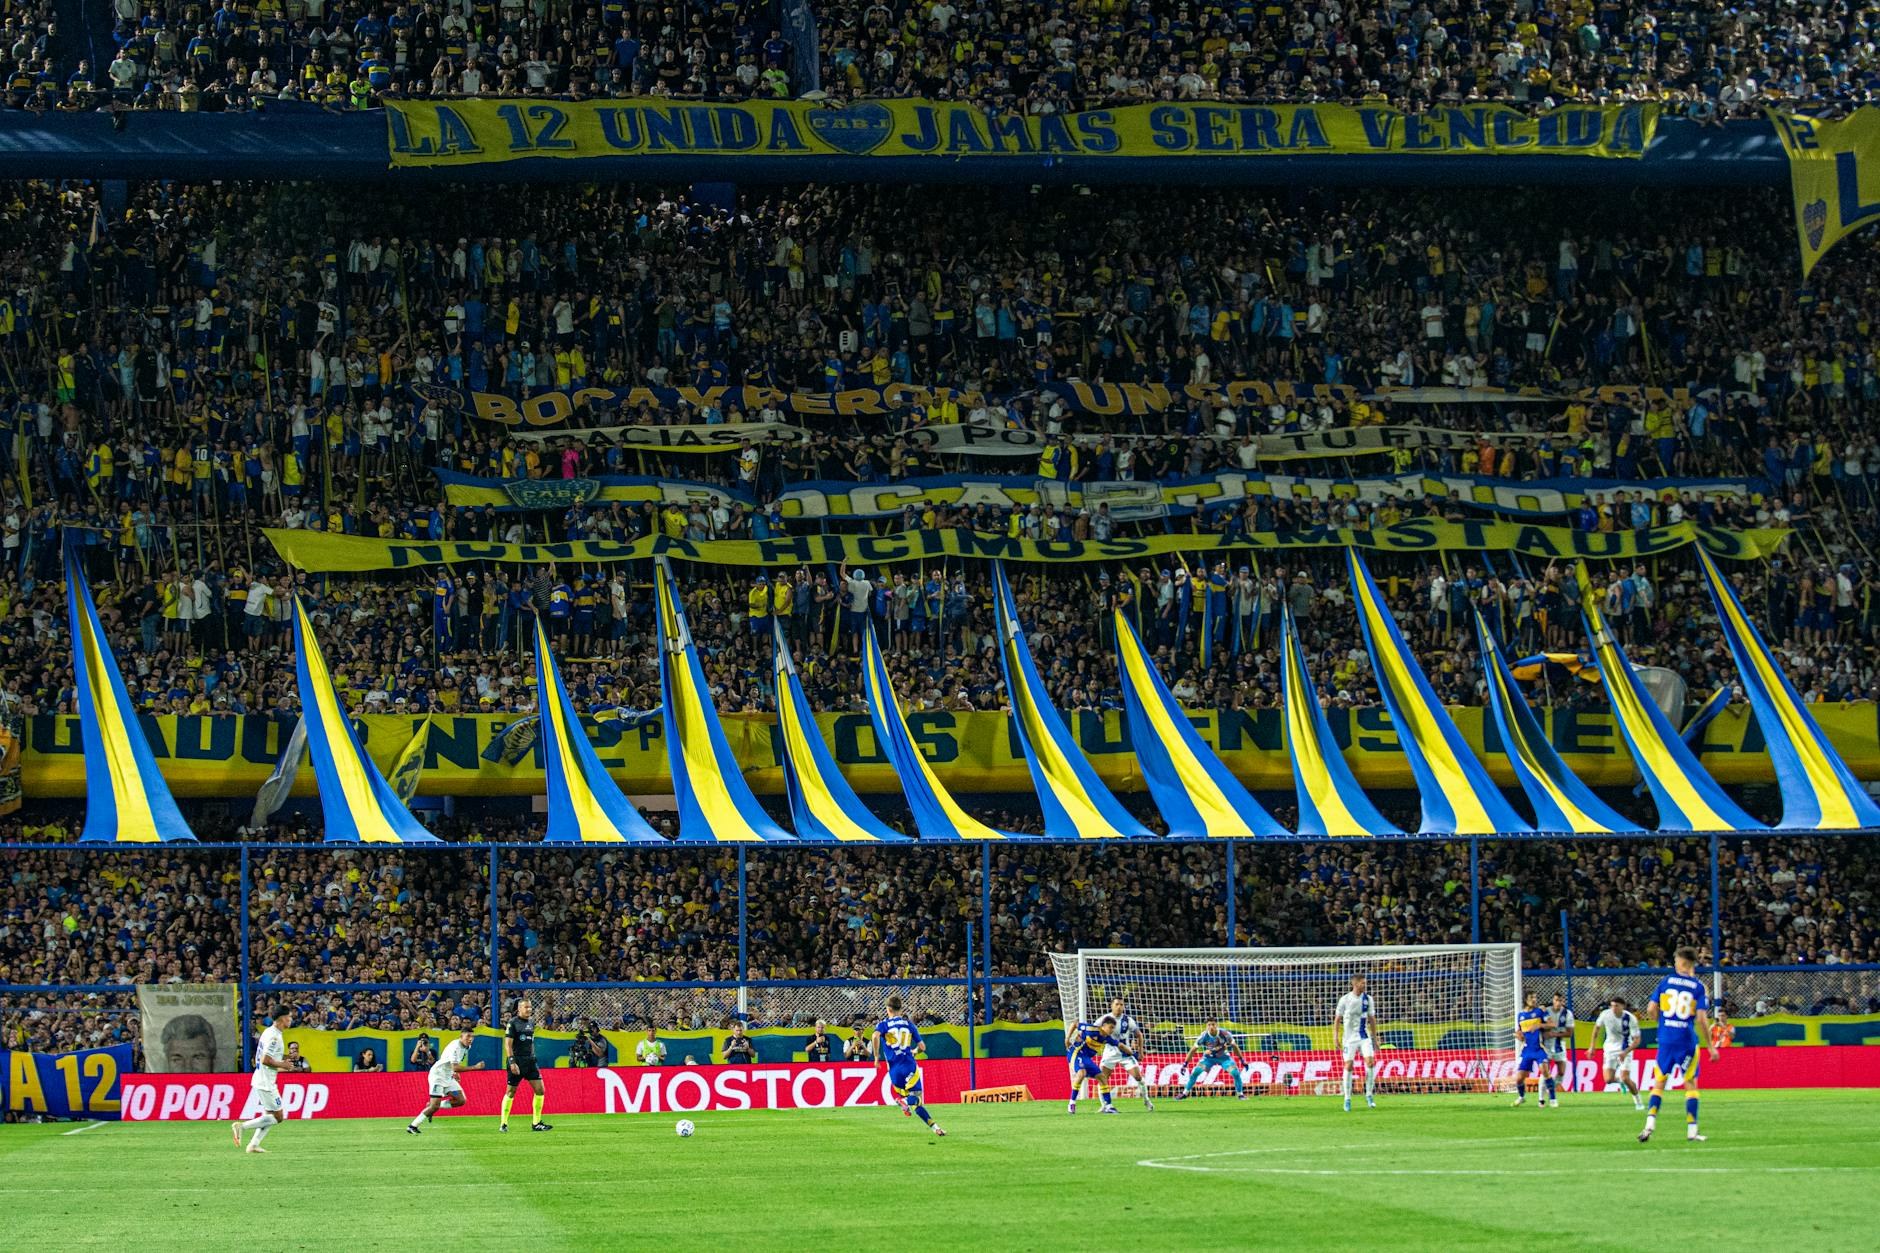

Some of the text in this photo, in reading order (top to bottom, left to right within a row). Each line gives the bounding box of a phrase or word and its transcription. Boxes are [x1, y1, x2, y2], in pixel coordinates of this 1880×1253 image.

[387, 104, 1650, 157] LA 12 UNIDA JAMAS SERA VENCIDA
[812, 117, 888, 130] CABJ
[1776, 114, 1819, 149] 12
[1071, 382, 1173, 416] UN
[195, 449, 208, 461] 10
[1280, 432, 1358, 451] TU
[389, 534, 700, 567] NUNCA
[759, 528, 1150, 563] HICIMOS
[8, 1049, 121, 1112] A 12
[160, 1084, 235, 1120] POR
